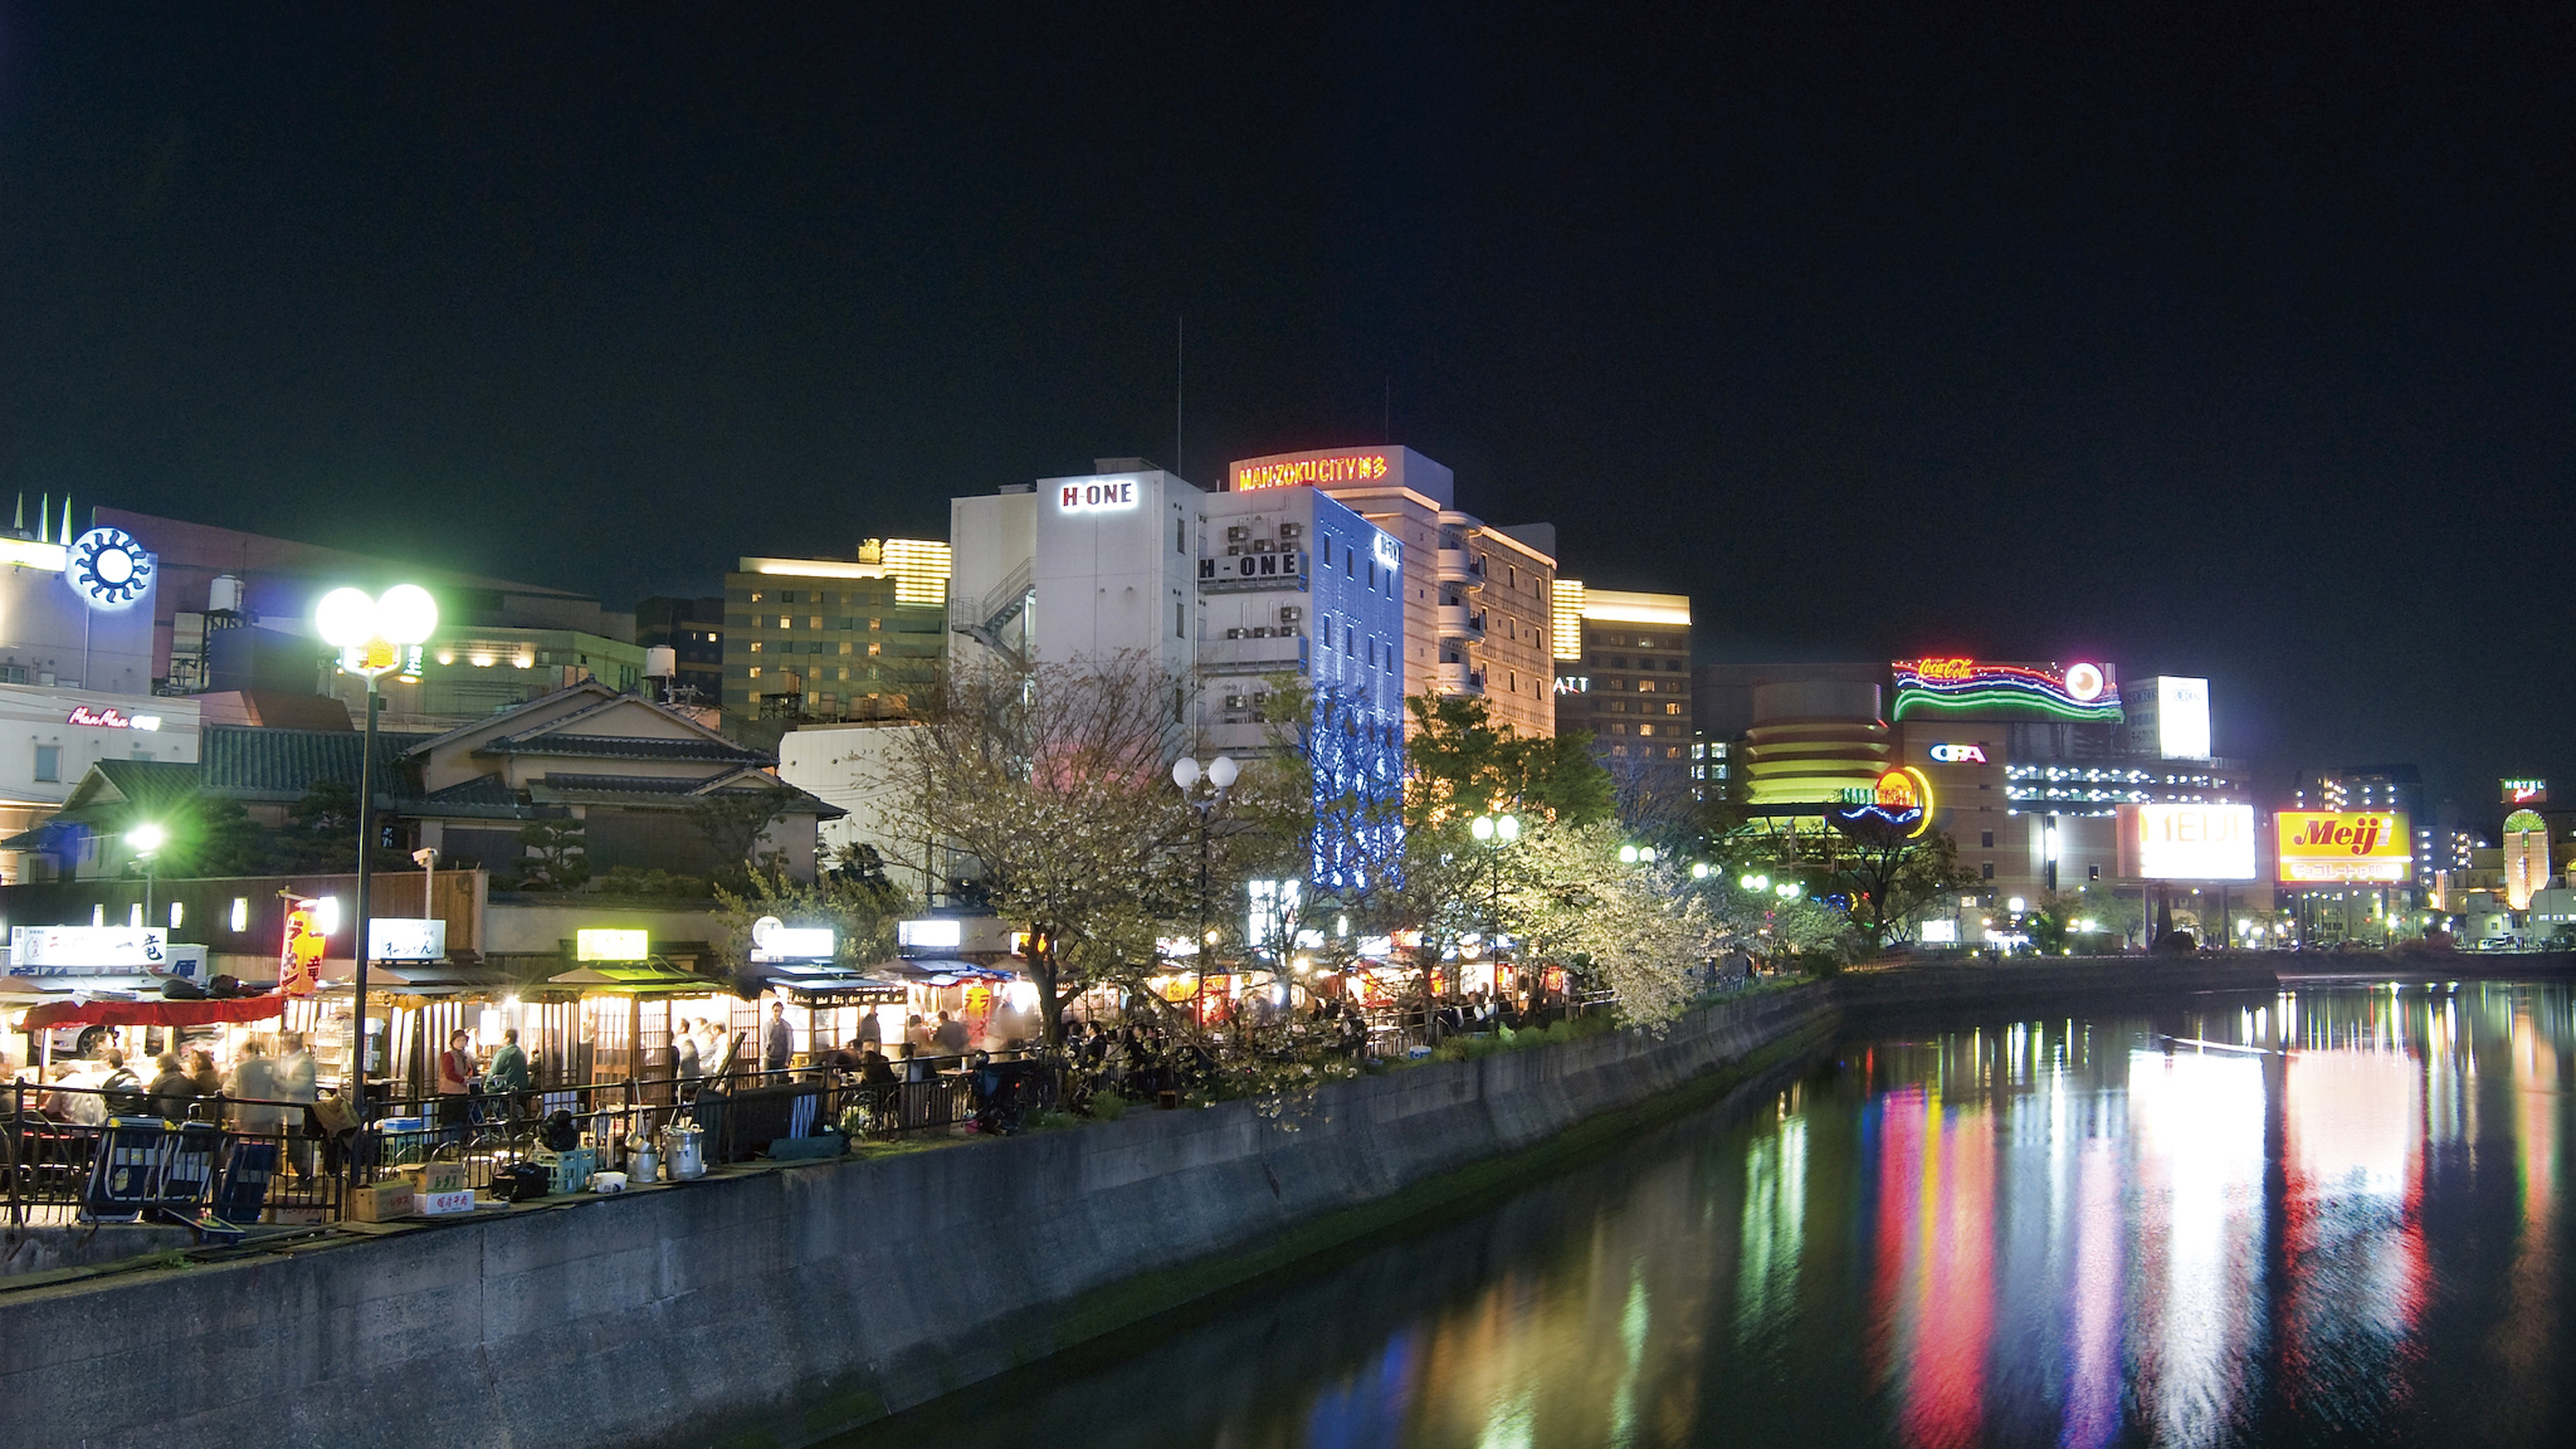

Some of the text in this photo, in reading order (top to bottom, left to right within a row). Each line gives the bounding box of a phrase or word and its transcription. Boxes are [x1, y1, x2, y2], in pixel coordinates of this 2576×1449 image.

[1319, 457, 1357, 483] CITY
[1063, 483, 1132, 506] H-ONE
[2504, 780, 2545, 789] HOTEL
[2293, 817, 2393, 855] Meiji
[281, 920, 303, 986] ラーメン
